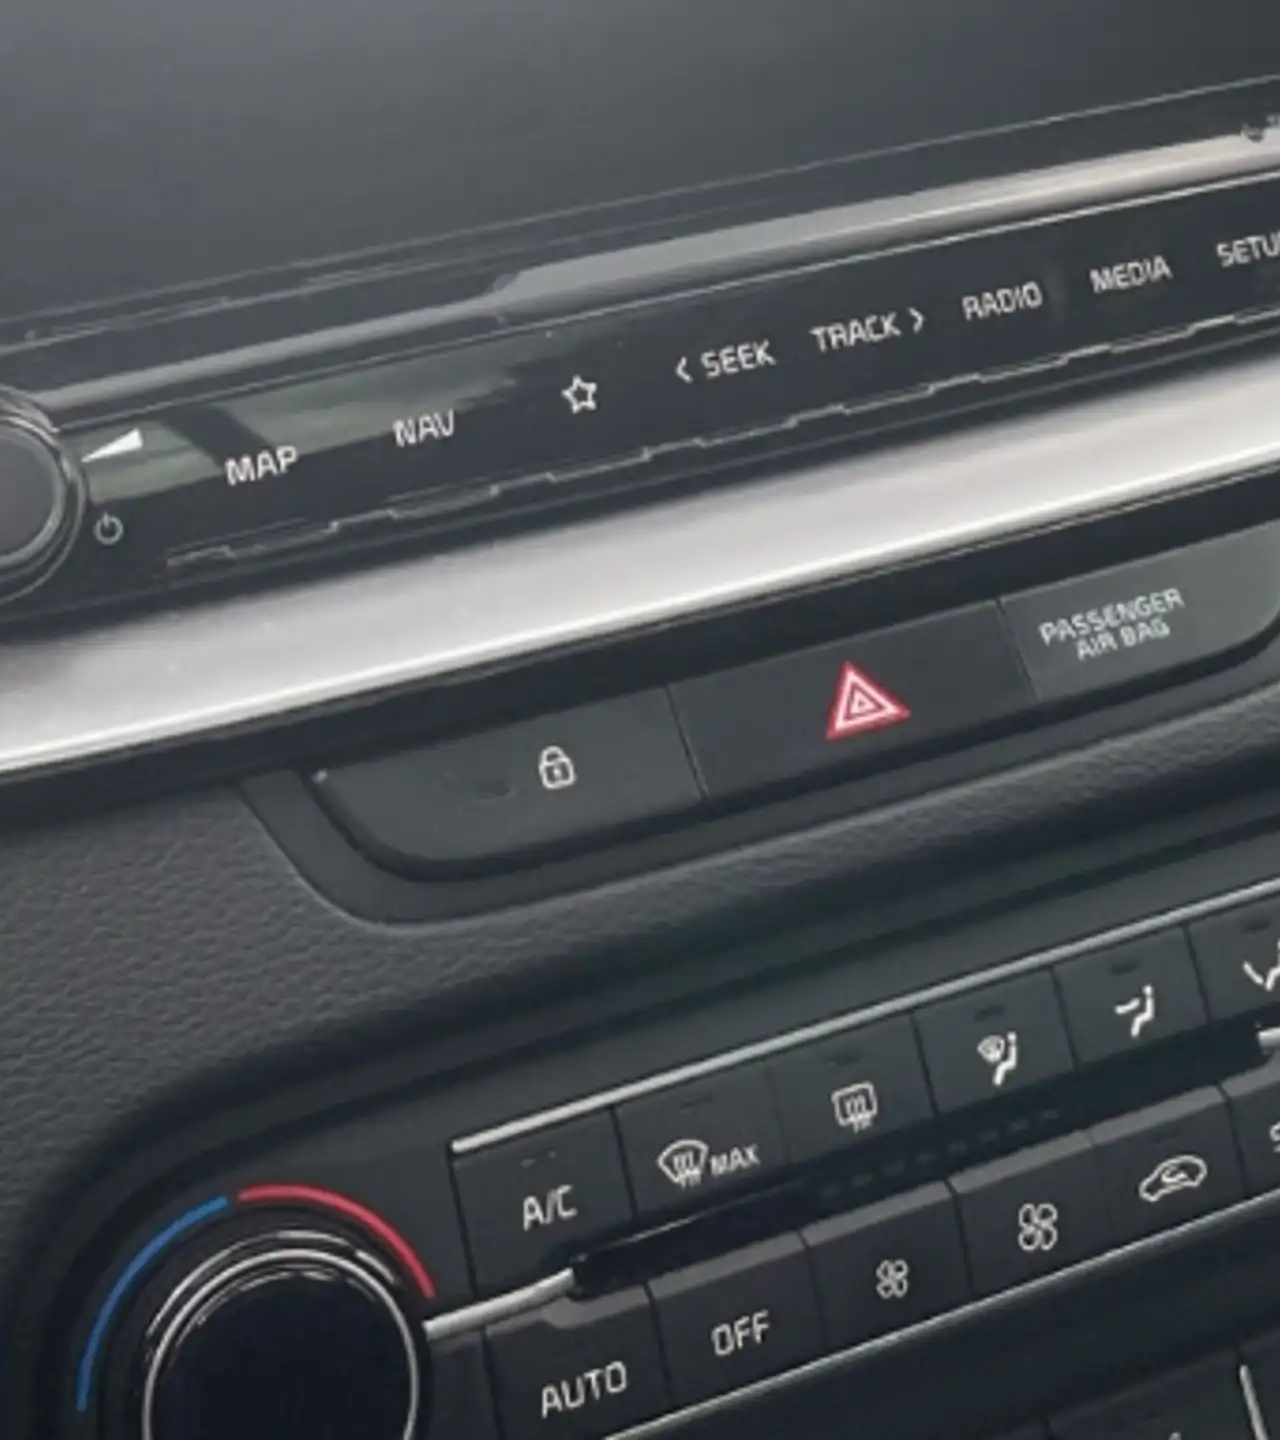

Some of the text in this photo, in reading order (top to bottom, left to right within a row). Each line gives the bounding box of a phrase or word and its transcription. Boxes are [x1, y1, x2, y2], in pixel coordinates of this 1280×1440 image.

[1090, 256, 1171, 294] MEDIA
[962, 282, 1042, 320] RADIO
[811, 313, 901, 352] TRACK
[701, 340, 776, 377] SEEK
[394, 410, 456, 447] NAV
[226, 447, 298, 485] MAP
[1038, 587, 1185, 645] PASSENGER
[1076, 618, 1170, 660] AIR BAG
[711, 1145, 760, 1176] MAX
[522, 1186, 577, 1231] A/C
[711, 1311, 769, 1356] OFF
[541, 1361, 627, 1418] AUTO
